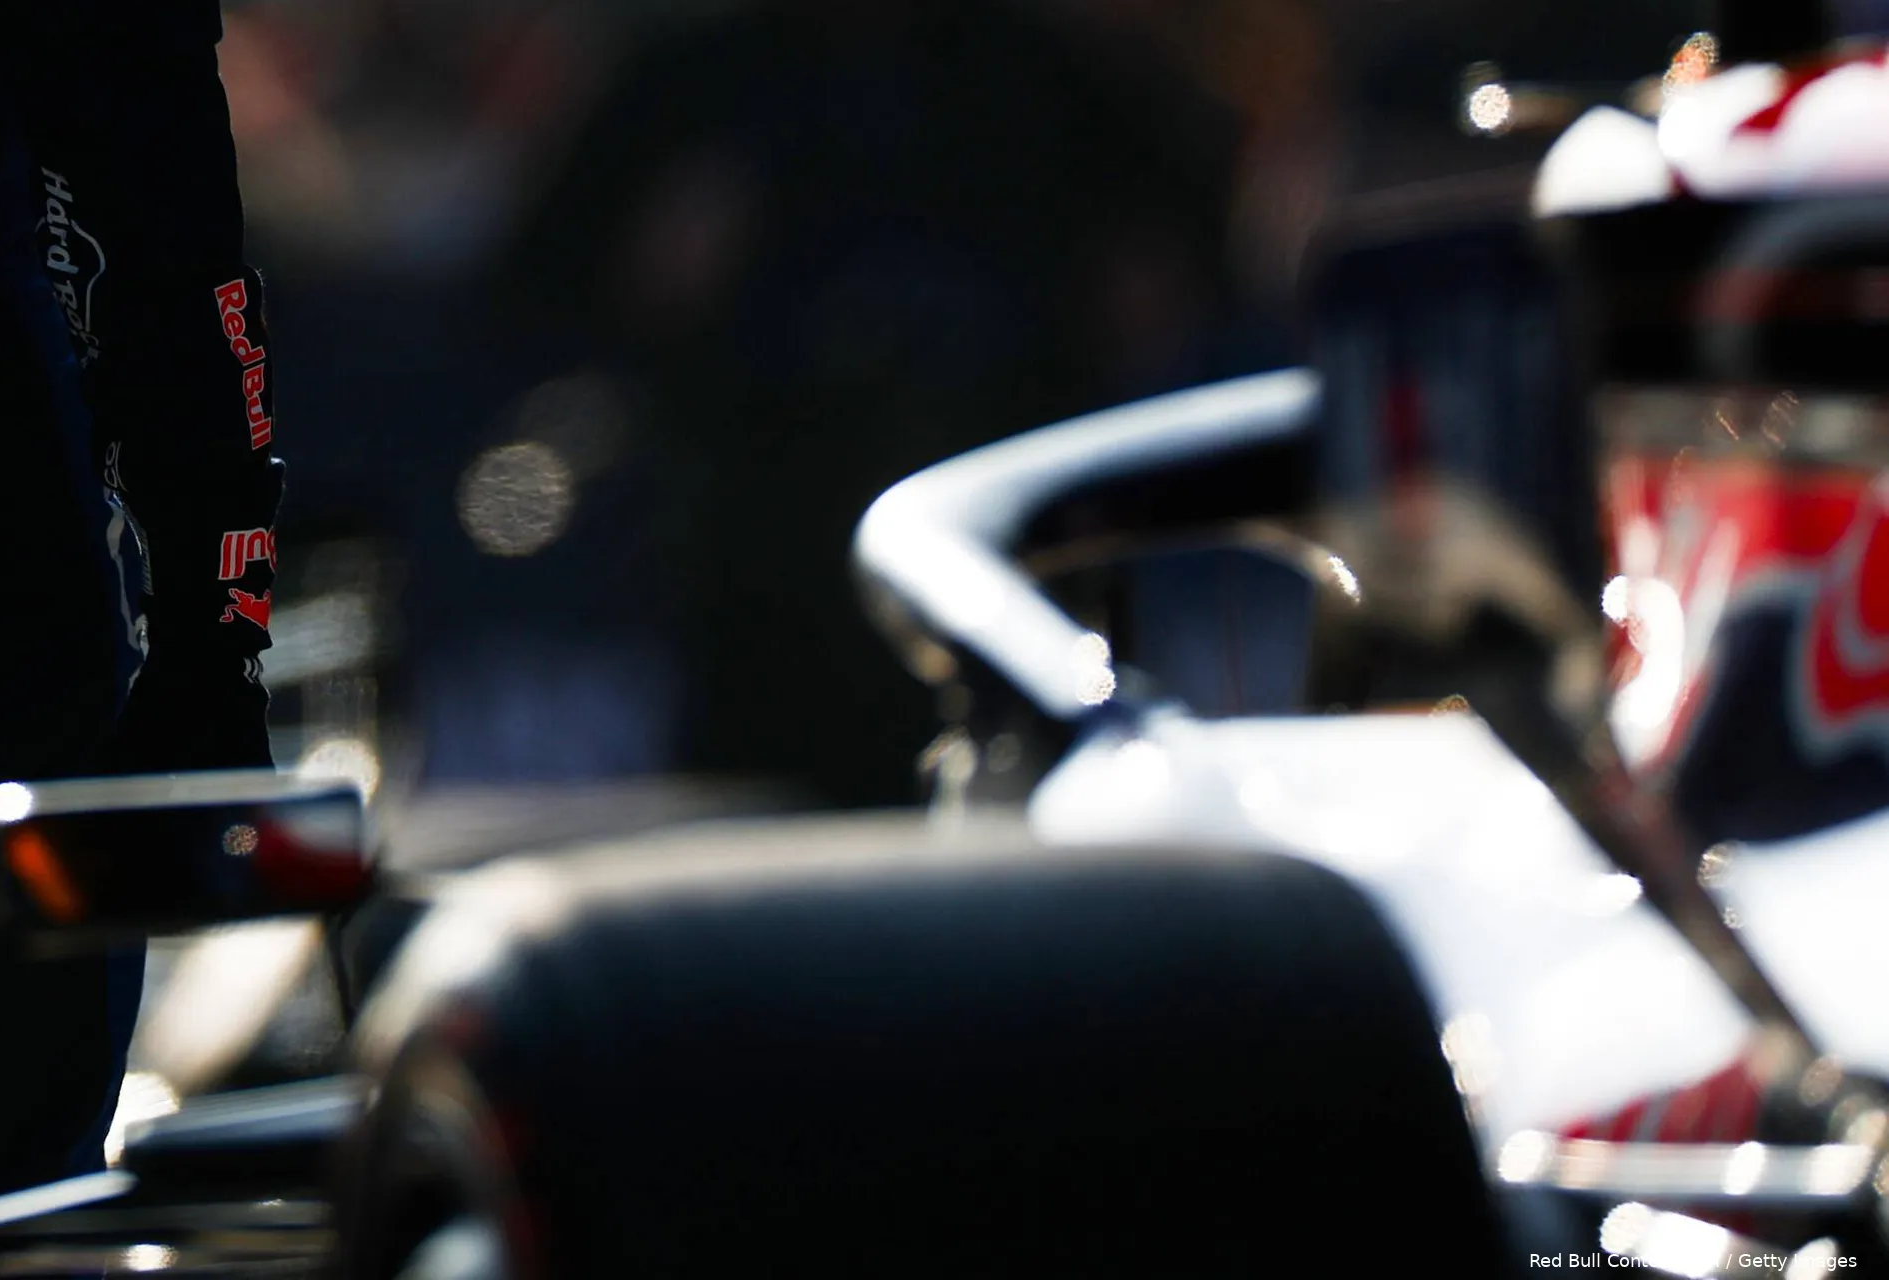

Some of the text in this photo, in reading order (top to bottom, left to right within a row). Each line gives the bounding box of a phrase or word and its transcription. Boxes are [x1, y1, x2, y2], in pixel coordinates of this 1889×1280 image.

[41, 166, 79, 276] Hard
[214, 279, 272, 450] Red Bull
